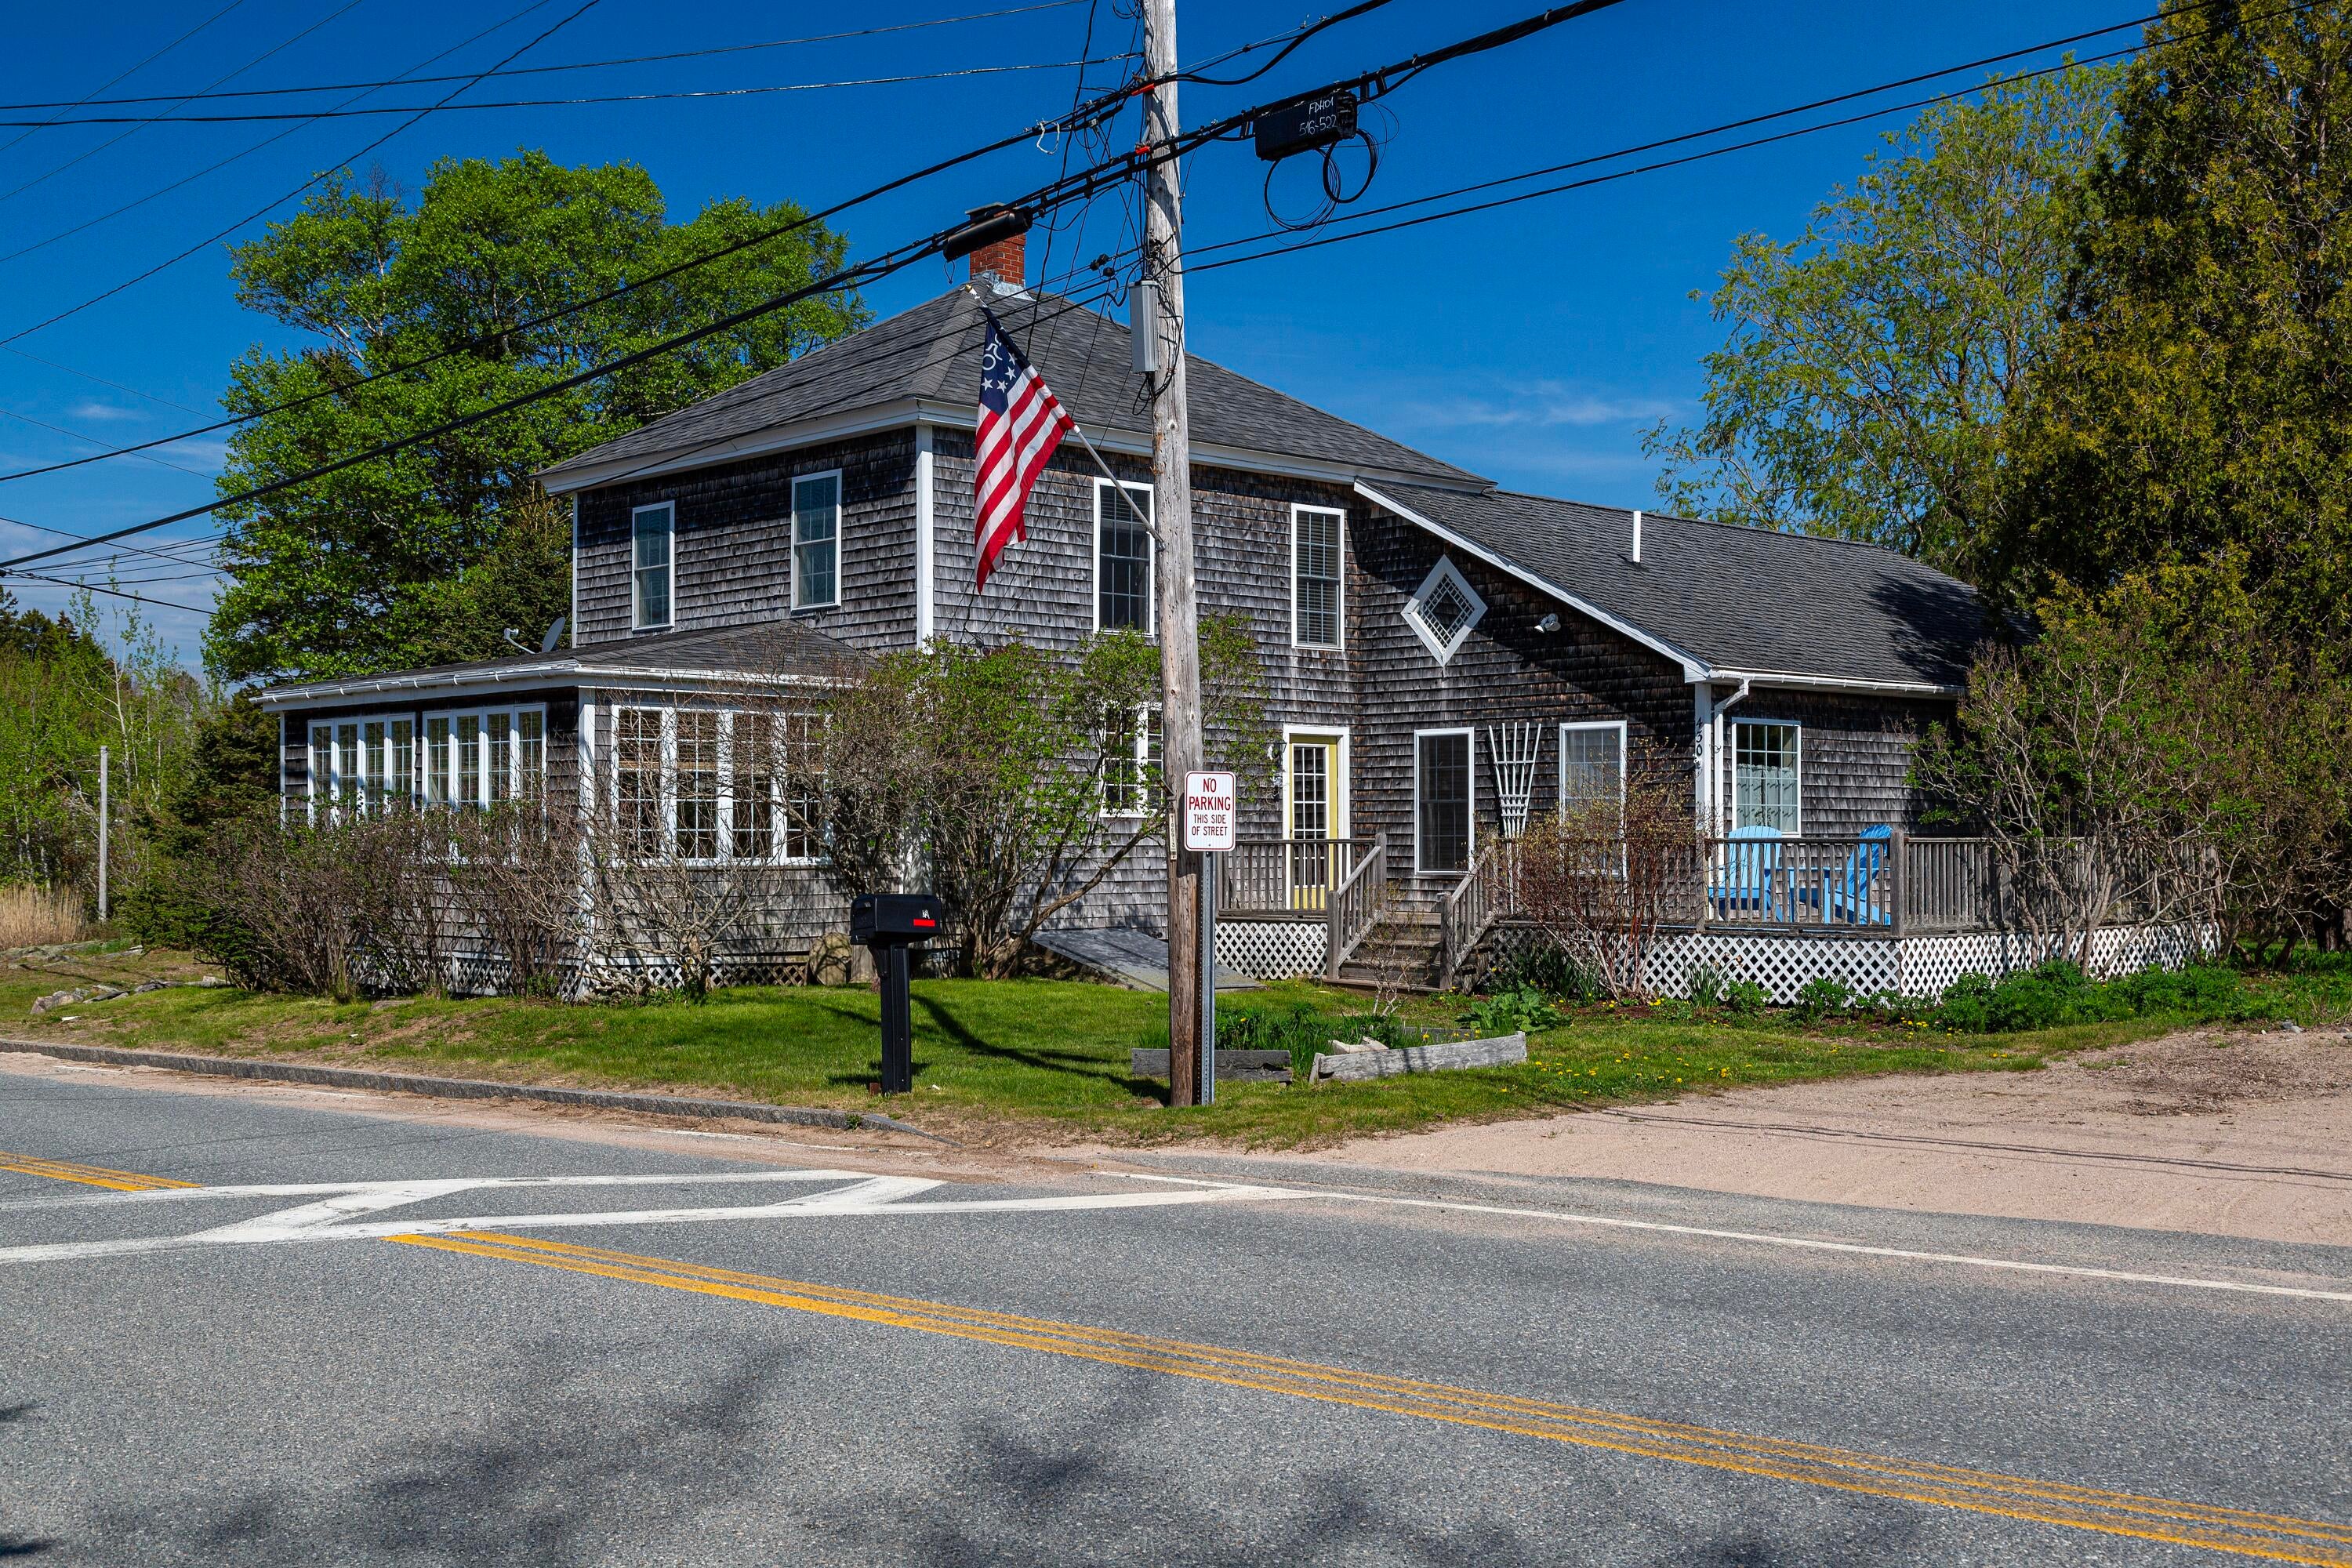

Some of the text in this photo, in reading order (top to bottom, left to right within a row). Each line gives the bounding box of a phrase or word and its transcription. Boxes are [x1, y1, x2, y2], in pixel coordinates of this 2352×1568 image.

[1308, 96, 1334, 114] FDH01
[1299, 114, 1338, 136] 516-522
[1203, 778, 1217, 793] NO
[1189, 797, 1231, 811] PARKING
[1194, 814, 1226, 824] THIS SIDE
[1192, 826, 1228, 837] OF STREET
